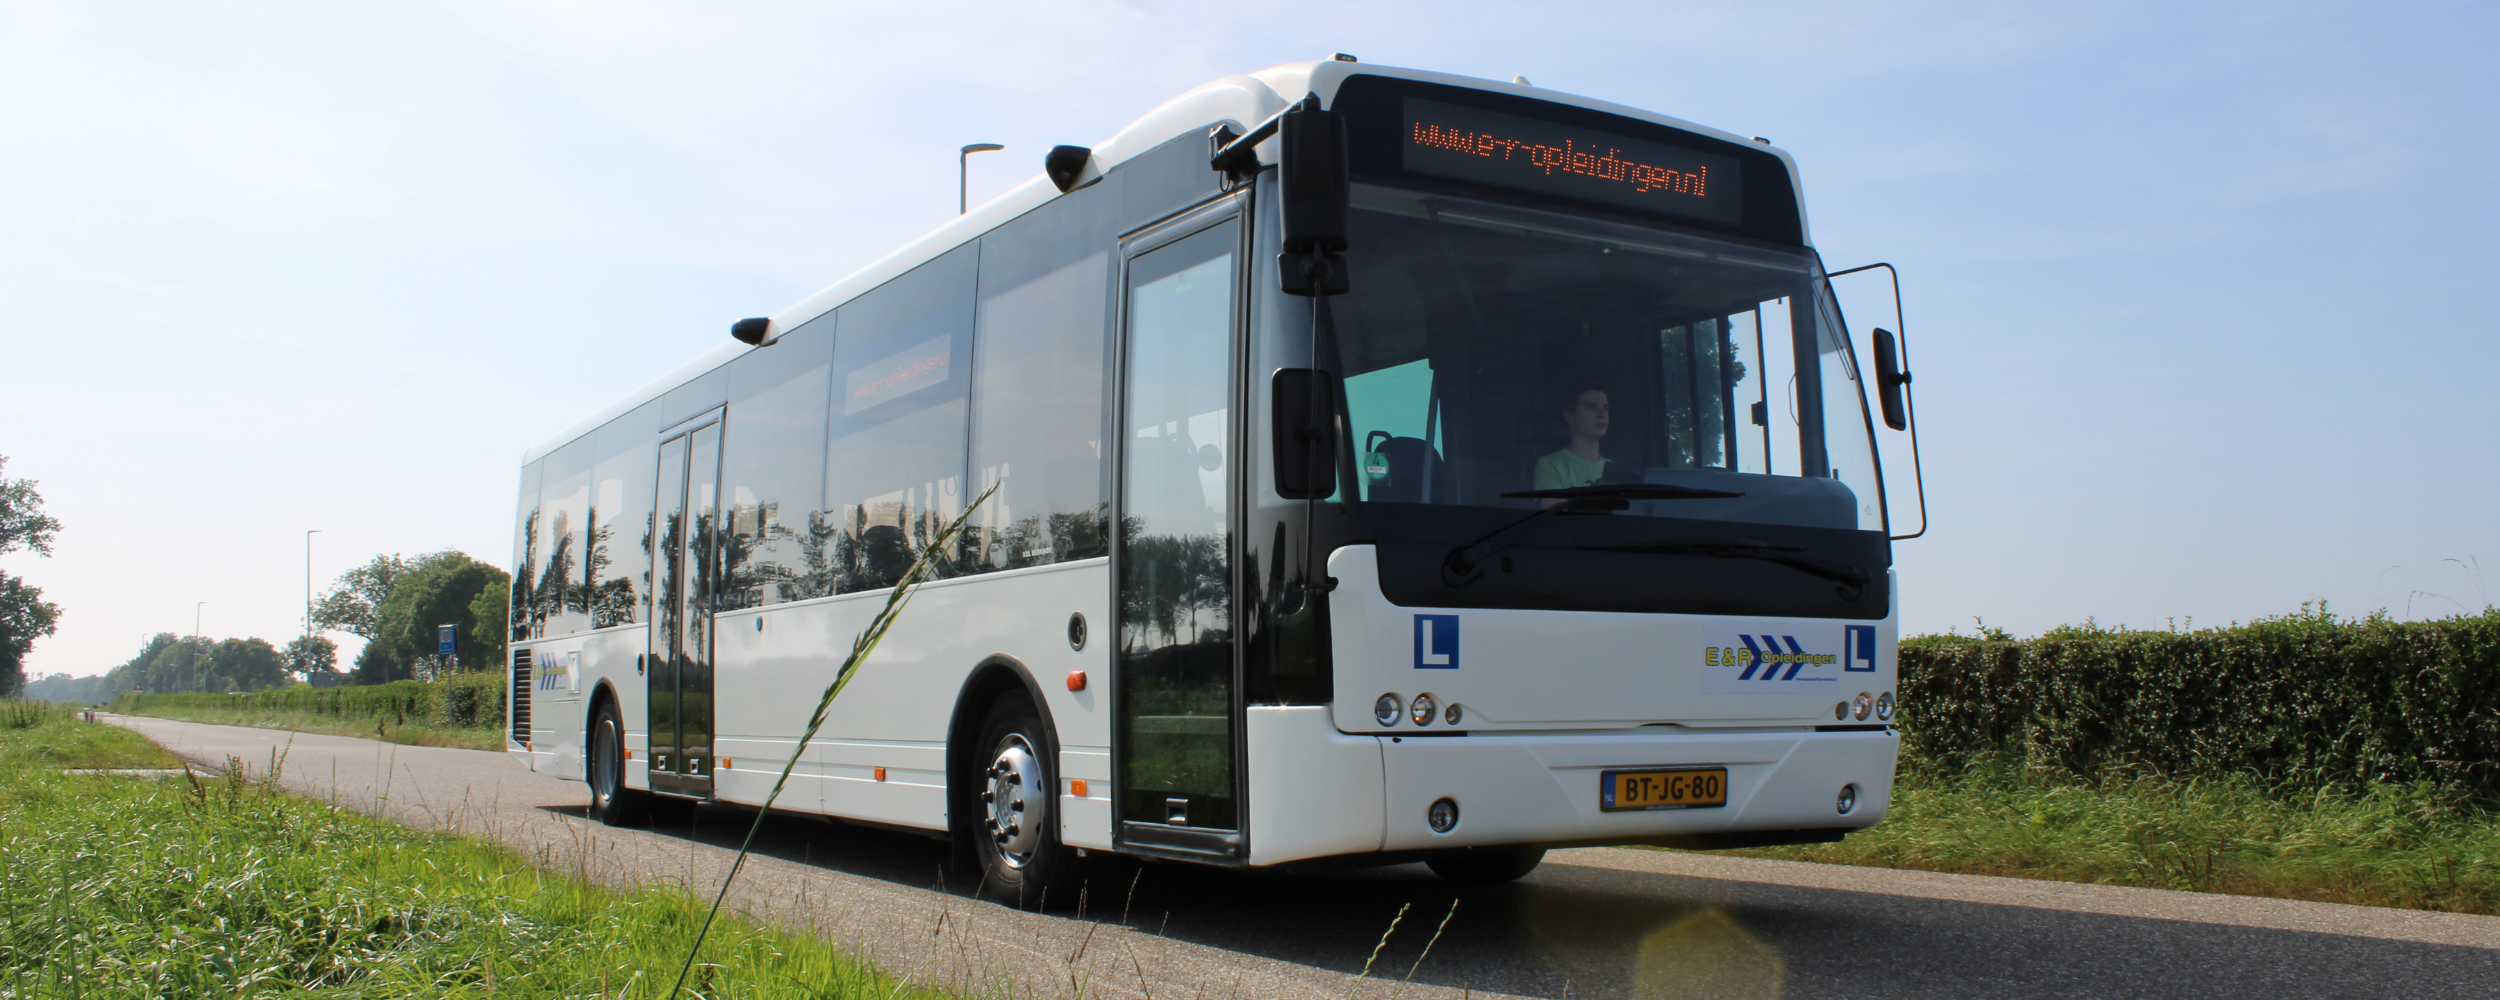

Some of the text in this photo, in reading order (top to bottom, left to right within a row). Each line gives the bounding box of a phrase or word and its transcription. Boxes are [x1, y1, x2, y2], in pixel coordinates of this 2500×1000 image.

[1414, 122, 1707, 196] www.e-r-opleidingen.nl
[1372, 454, 1380, 466] 4
[1422, 619, 1449, 664] L
[1850, 629, 1869, 668] L
[1760, 650, 1837, 667] Opleidingen
[1604, 794, 1613, 802] NL
[1626, 775, 1719, 802] BT-JG-80
